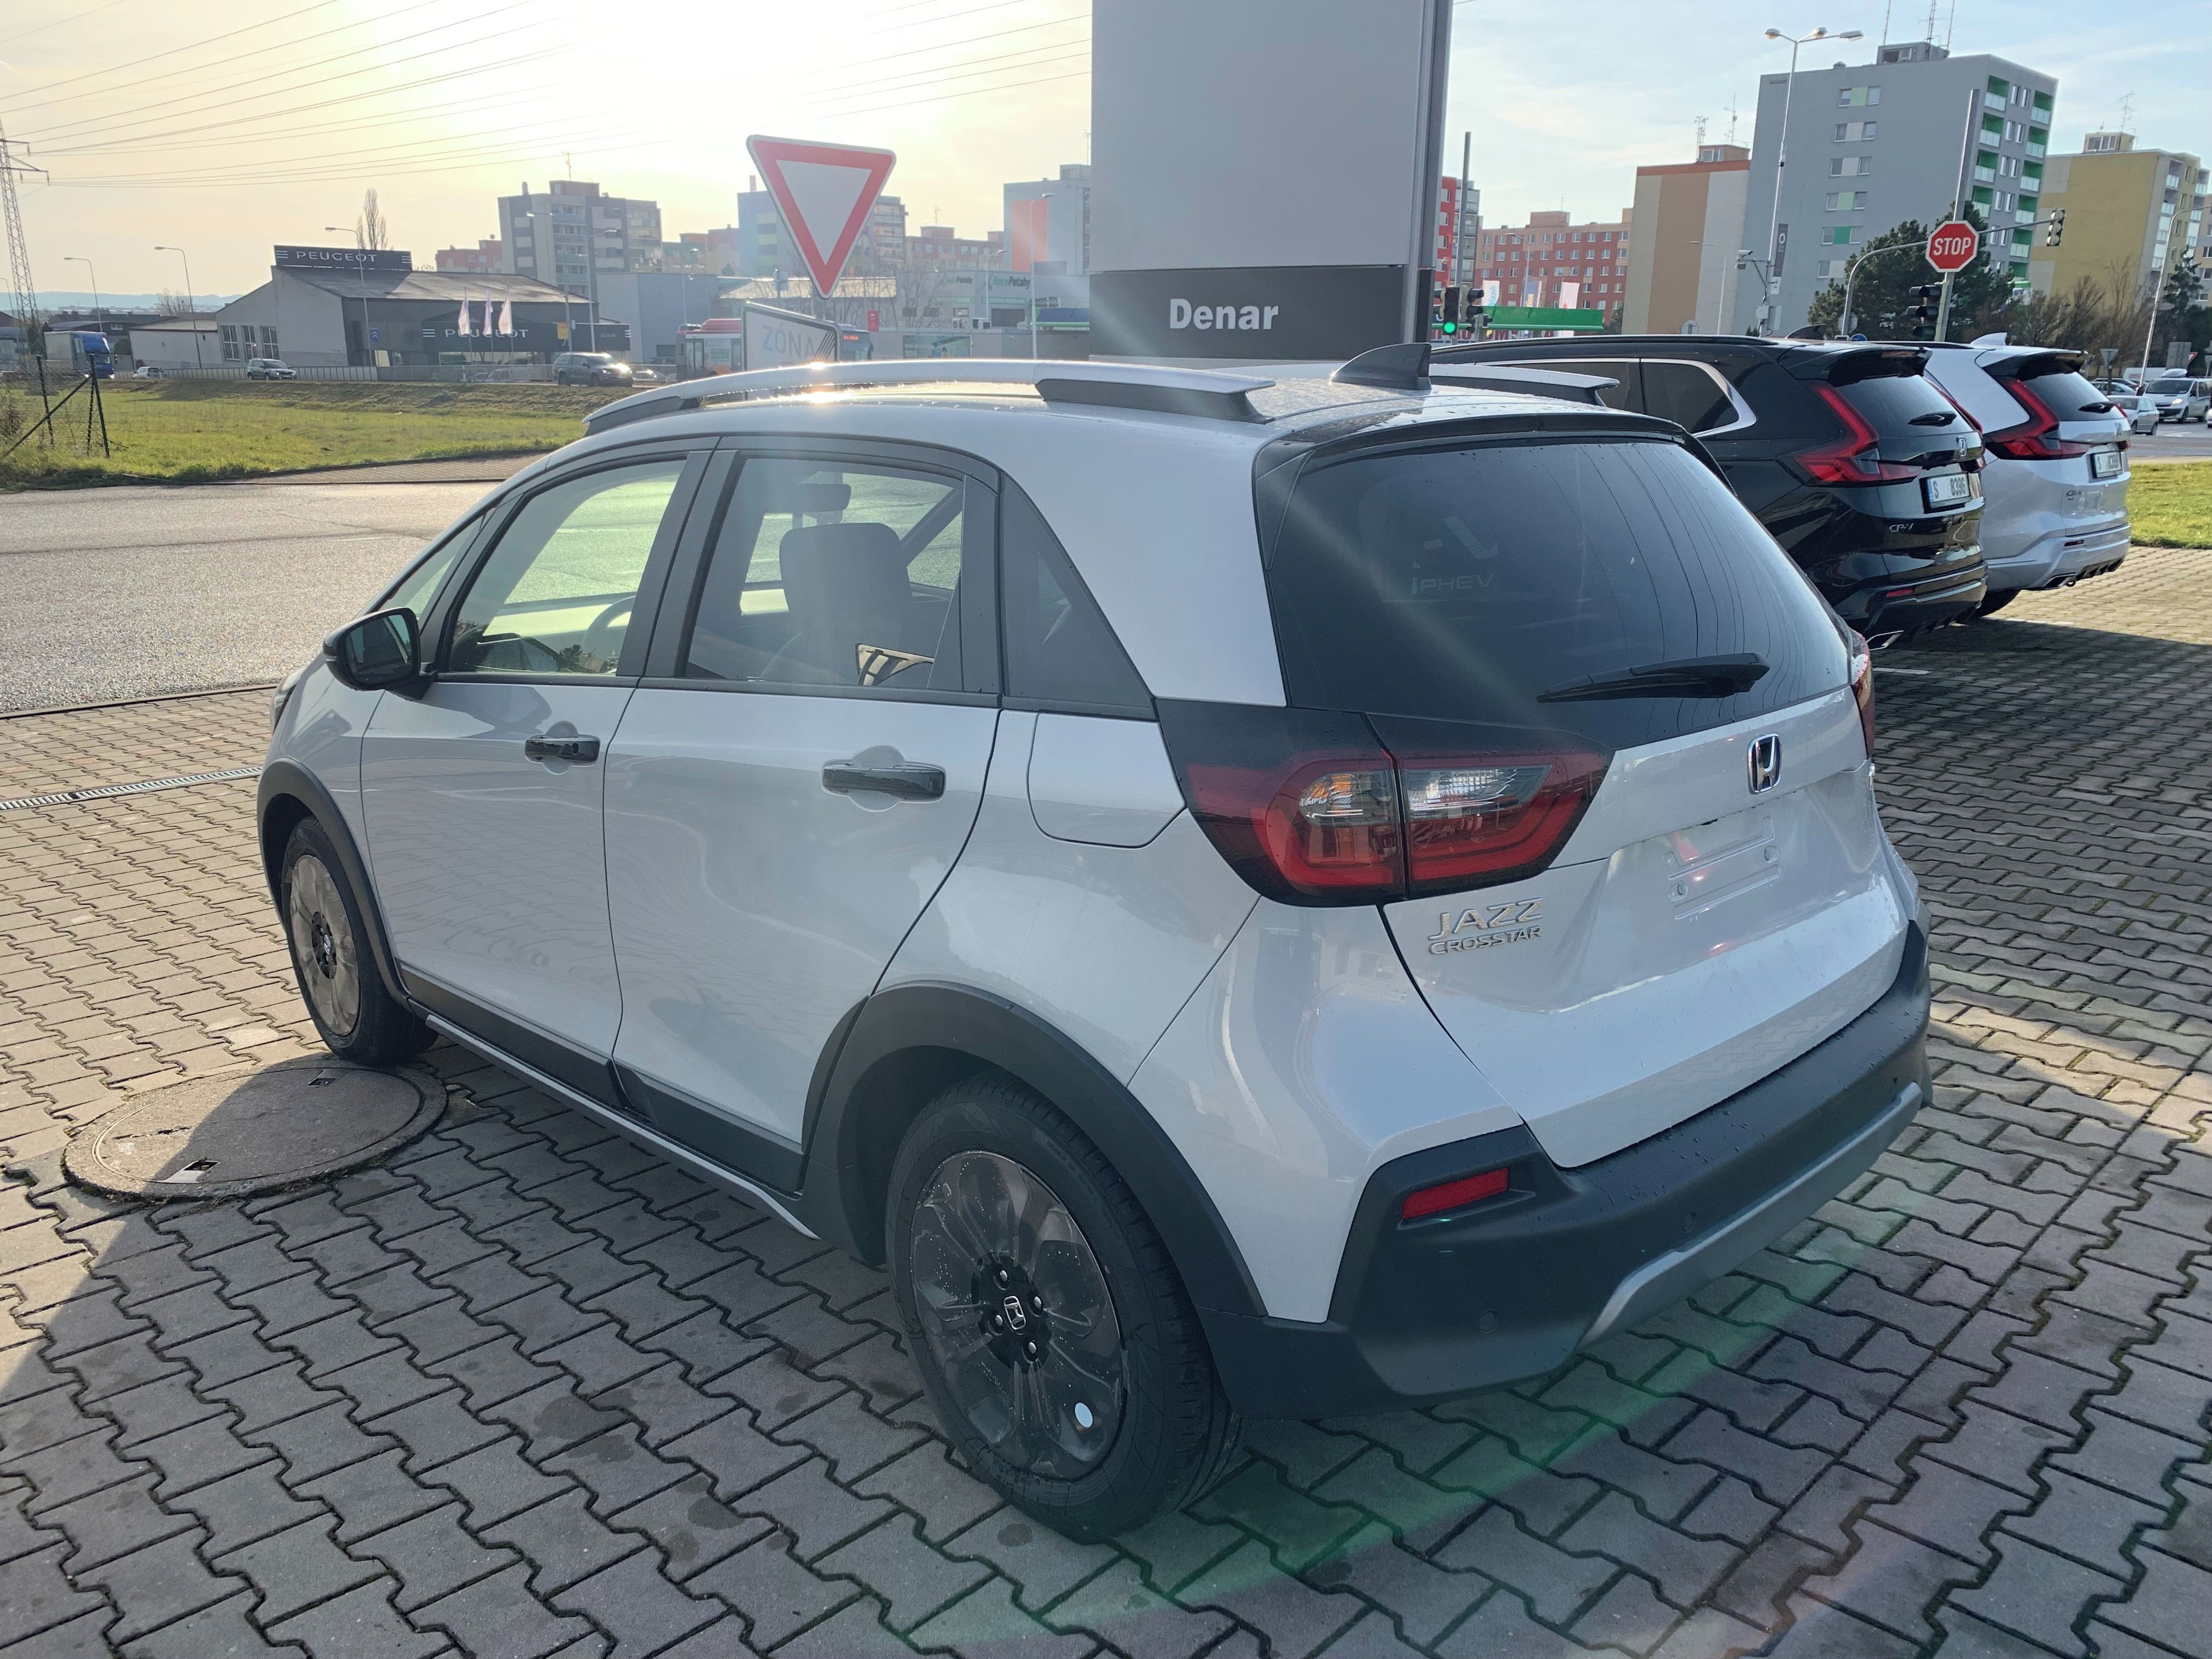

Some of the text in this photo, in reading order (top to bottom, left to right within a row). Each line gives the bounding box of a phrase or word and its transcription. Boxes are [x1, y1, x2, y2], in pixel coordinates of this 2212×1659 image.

[296, 251, 377, 262] PEUGEOT
[1933, 236, 1972, 256] STOP
[1170, 298, 1279, 330] Denar
[762, 322, 817, 360] ZÓNA
[1933, 480, 1939, 499] S
[1428, 897, 1543, 940] JAZZ
[1429, 925, 1542, 955] CROSSTAR
